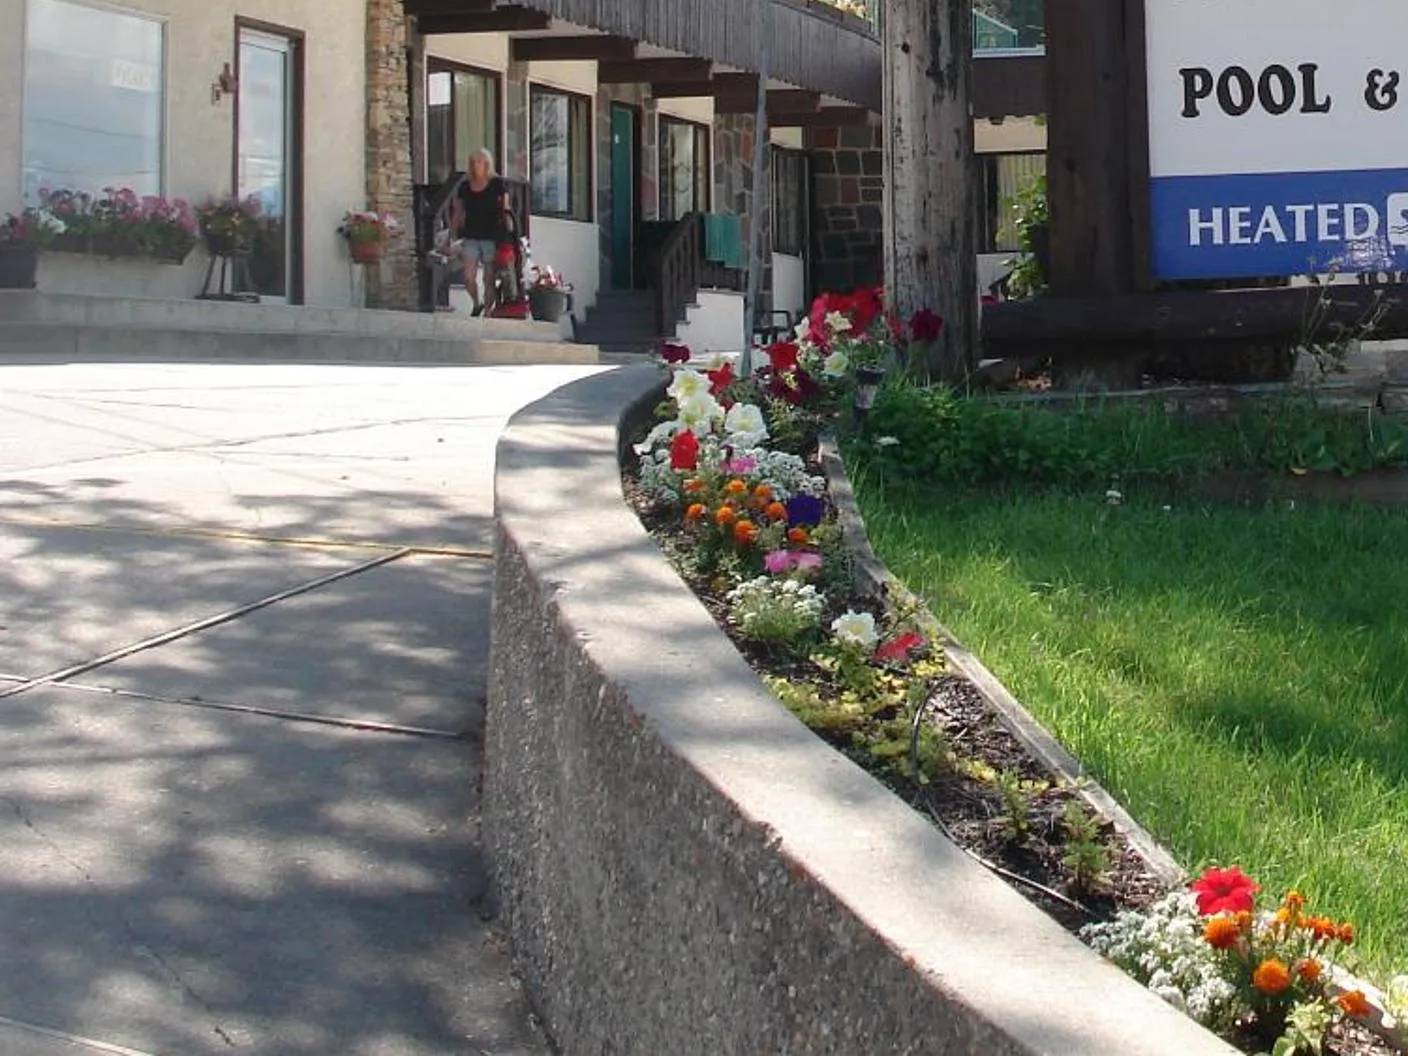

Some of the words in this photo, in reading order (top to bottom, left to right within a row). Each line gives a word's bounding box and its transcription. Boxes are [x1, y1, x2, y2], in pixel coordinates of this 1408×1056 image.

[1178, 62, 1332, 119] POOL
[1364, 68, 1400, 112] &
[1188, 203, 1379, 245] HEATED
